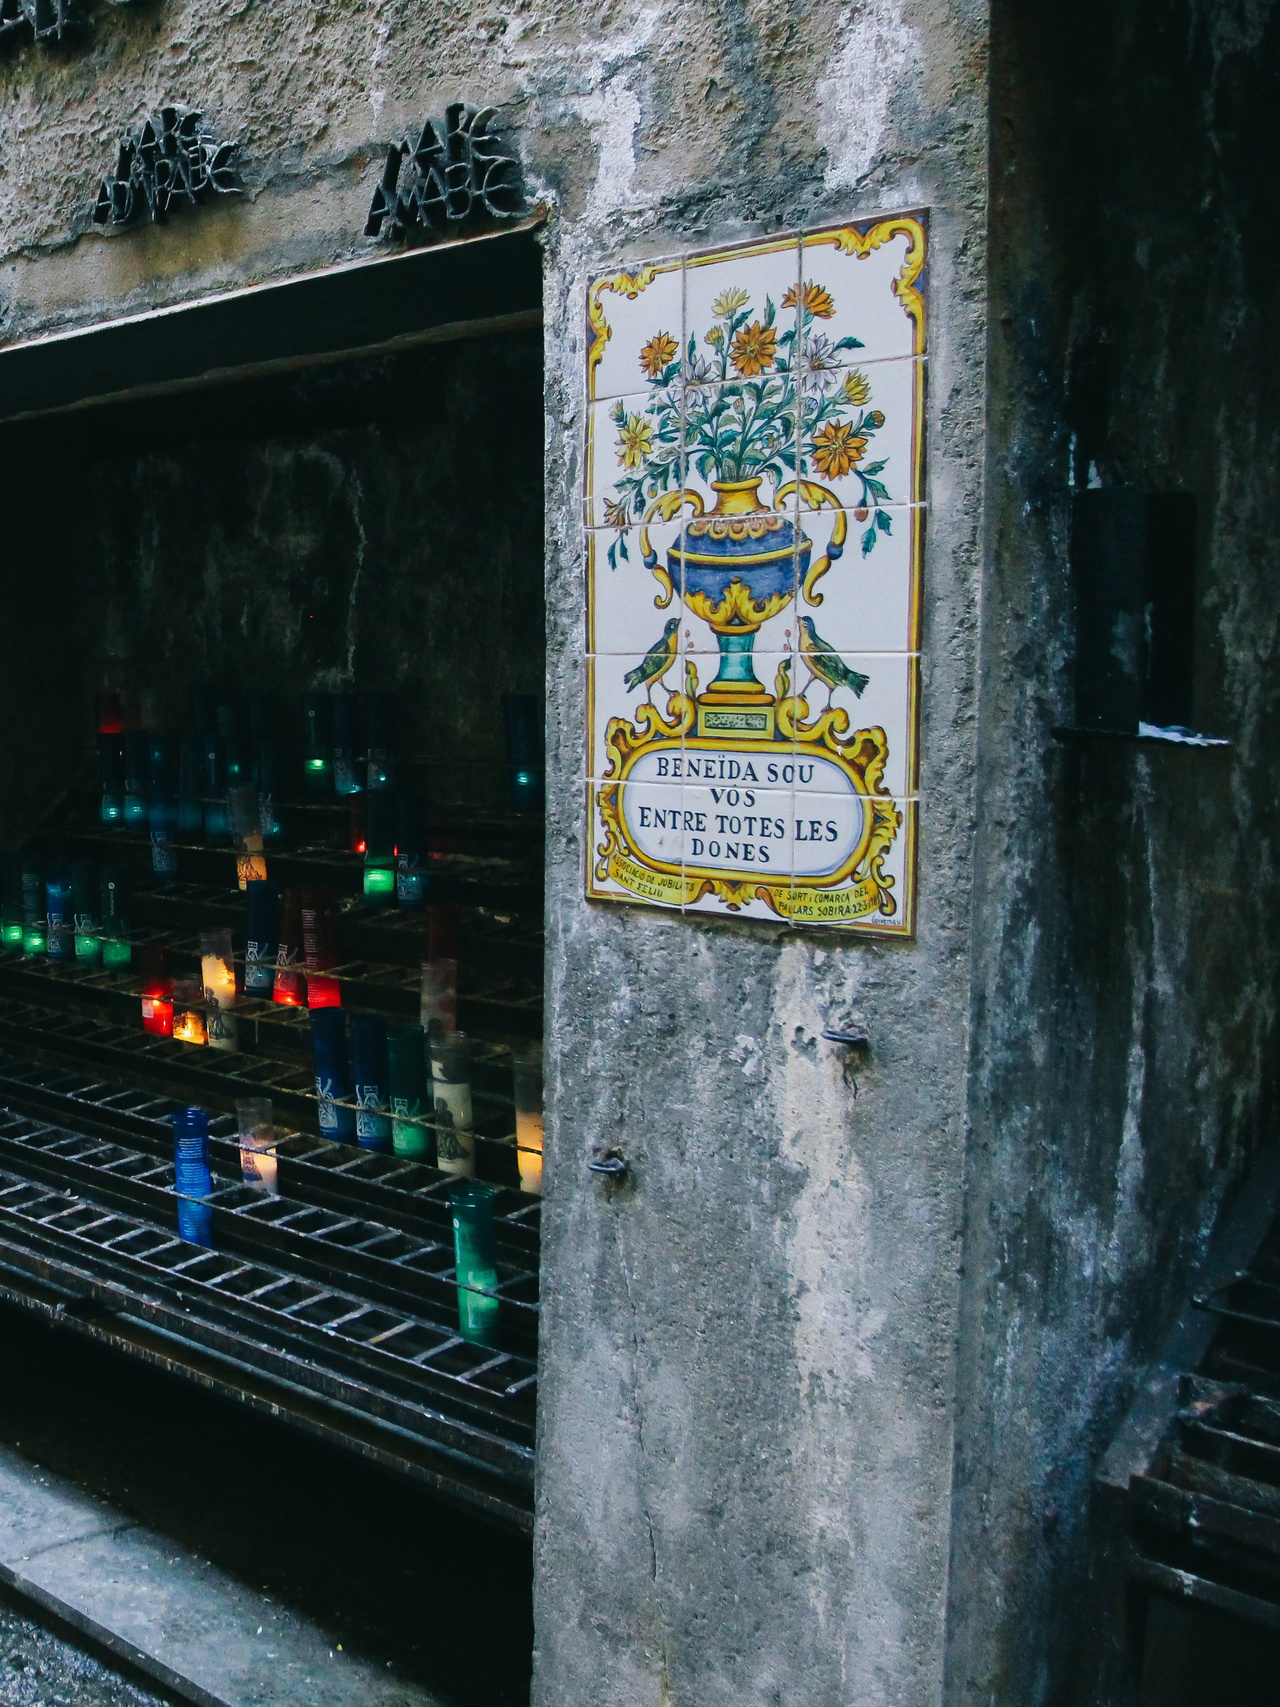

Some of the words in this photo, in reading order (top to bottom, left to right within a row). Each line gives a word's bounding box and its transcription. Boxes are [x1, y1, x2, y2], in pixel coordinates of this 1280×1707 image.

[655, 755, 759, 783] BENEÏDA
[766, 763, 815, 784] SOU
[638, 806, 708, 832] ENTRE
[715, 814, 785, 840] TOTES
[795, 819, 839, 842] LES
[691, 838, 771, 864] DONES
[613, 868, 636, 886] SANT
[636, 882, 664, 898] FELIU
[646, 874, 656, 885] DE
[814, 892, 850, 904] COMARCA
[854, 885, 869, 899] DEL
